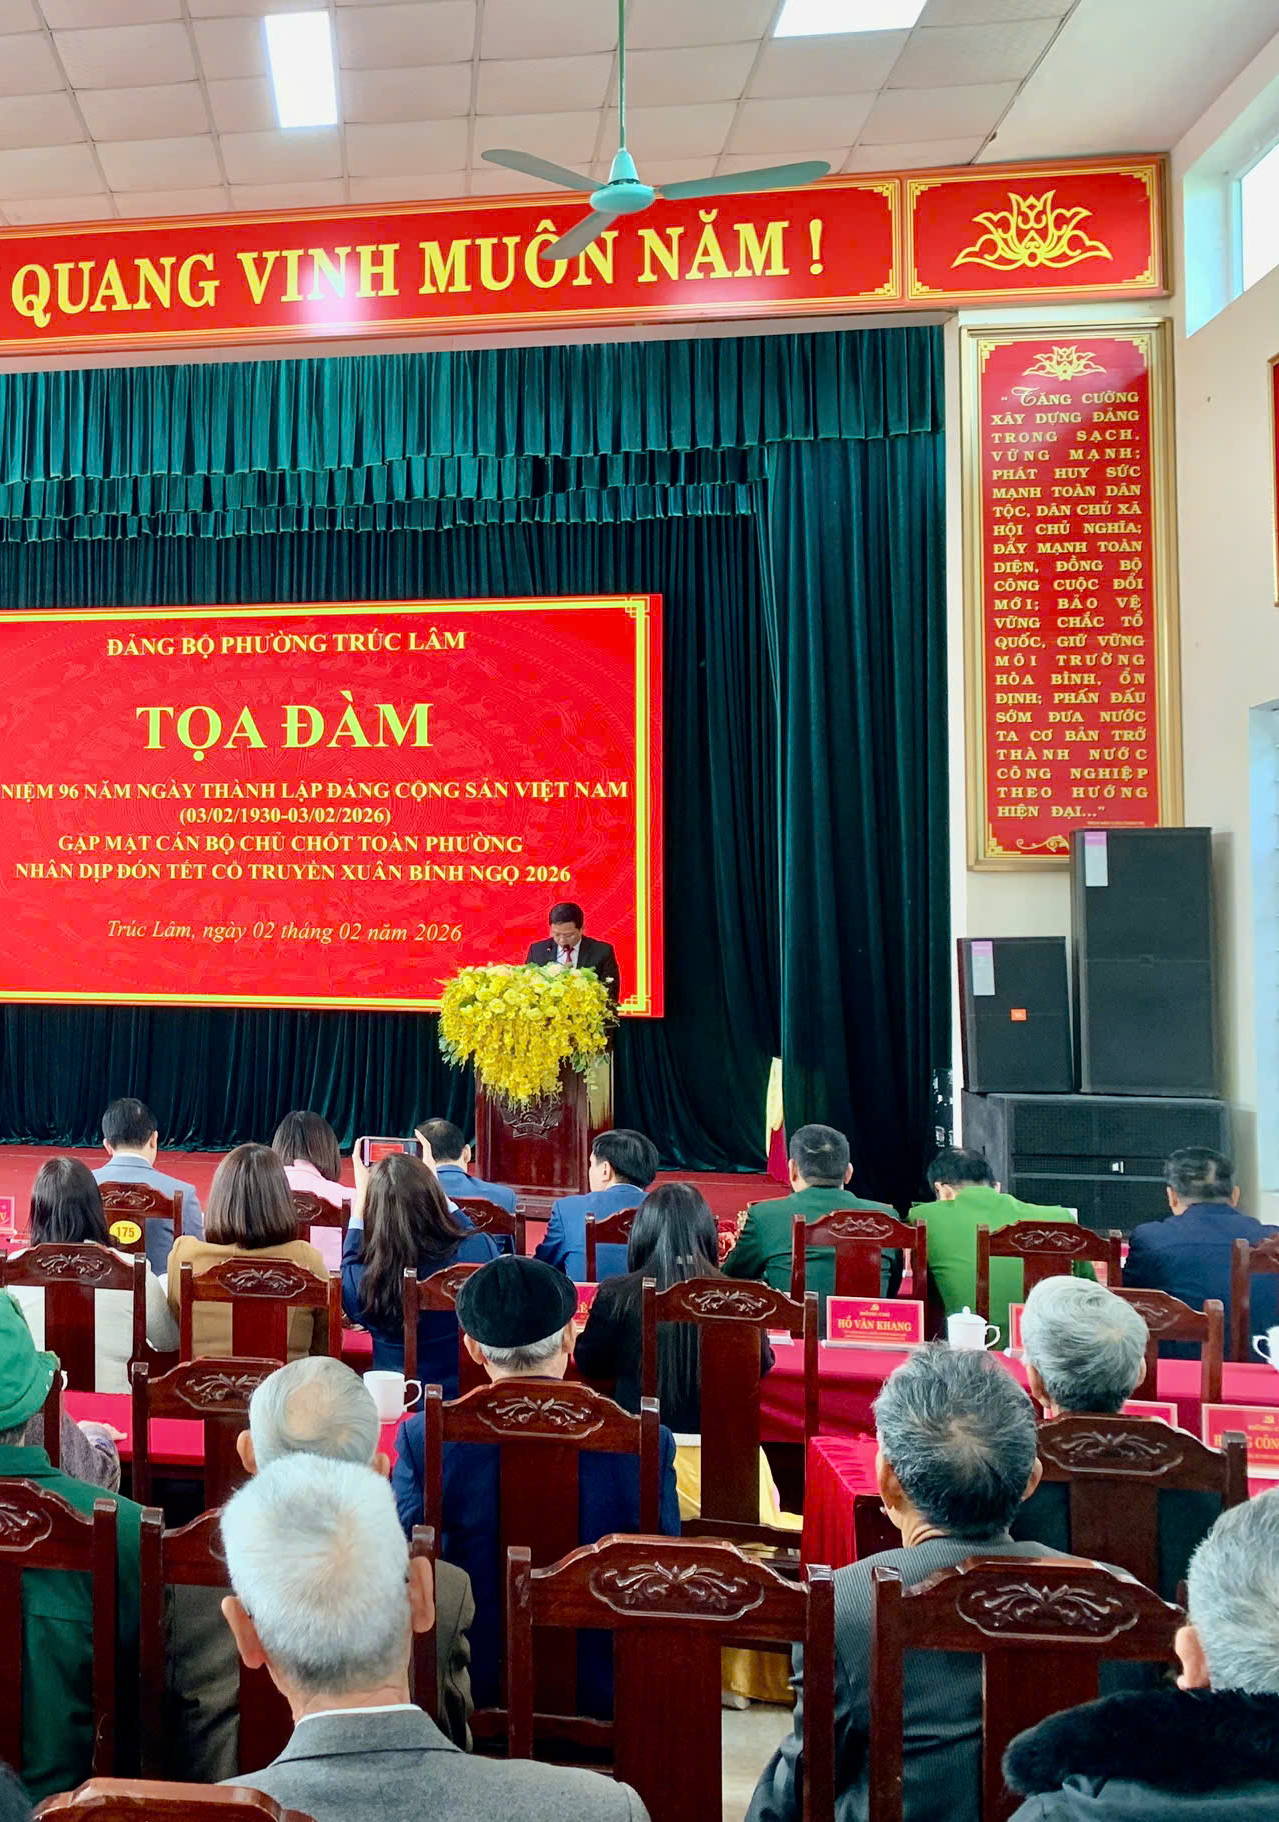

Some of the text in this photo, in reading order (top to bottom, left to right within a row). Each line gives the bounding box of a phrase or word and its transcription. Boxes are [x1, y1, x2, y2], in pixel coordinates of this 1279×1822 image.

[10, 254, 220, 328] QUANG
[237, 242, 402, 303] VINH
[418, 221, 620, 295] MUÔN
[638, 208, 791, 284] NĂM
[991, 407, 1140, 426] XÂY DỰNG ĐẢNG
[992, 464, 1141, 480] PHÁT HUY SỨC
[992, 483, 1141, 501] MẠNH TOÀN DÂN
[1036, 503, 1072, 516] DÂN
[1076, 500, 1112, 515] CHỦ
[1117, 501, 1142, 515] XÃ
[993, 522, 1024, 538] HỘI
[1035, 520, 1070, 535] CHỦ
[1037, 542, 1088, 555] MẠNH
[1097, 539, 1143, 552] TOÀN
[993, 572, 1144, 592] CÔNG CUỘC ĐỔI
[993, 610, 1144, 629] VỮNG CHẮC TỔ
[107, 627, 466, 659] ĐẢNG BỘ PHƯỜNG TRÚC LÂM
[995, 652, 1145, 666] MÔI TRƯỜNG
[1053, 688, 1100, 704] PHẤN
[1110, 687, 1146, 704] ĐẤU
[995, 708, 1146, 723] SỚM ĐƯA NƯỚC
[136, 690, 434, 762] TỌA ĐÀM
[996, 726, 1147, 741] TA CƠ BẢN TRỞ
[996, 747, 1147, 760] THÀNH NƯỚC
[996, 765, 1148, 781] CÔNG NGHIỆP
[1, 781, 54, 803] NIỆM
[58, 784, 79, 799] 96
[84, 780, 132, 799] NĂM
[137, 779, 196, 799] NGÀY
[201, 778, 276, 799] THÀNH
[281, 780, 321, 803] LẬP
[328, 777, 390, 799] ĐẢNG
[395, 778, 460, 803] CỘNG
[465, 777, 509, 799] SẢN
[515, 778, 569, 803] VIỆT
[574, 781, 628, 798] NAM
[996, 784, 1149, 798] THEO HƯỚNG
[180, 807, 392, 826] (03/02/1930-03/02/2026)
[156, 832, 199, 852] CÁN
[205, 833, 235, 855] BỘ
[240, 831, 286, 852] CHỦ
[291, 830, 353, 852] CHỐT
[359, 832, 418, 852] TOÀN
[426, 832, 523, 853] PHƯỜNG
[15, 859, 75, 879] NHÂN
[79, 862, 113, 883] DỊP
[116, 860, 161, 879] ĐÓN
[167, 859, 206, 879] TẾT
[341, 861, 402, 881] XUÂN
[408, 861, 464, 881] BÍNH
[470, 864, 520, 885] NGỌ
[526, 865, 571, 882] 2026
[107, 920, 462, 944] Trúc Lâm, ngày 02 tháng 02 năm 2026
[116, 1227, 135, 1238] 175
[854, 1318, 874, 1330] VĂN
[876, 1320, 912, 1332] KHANG
